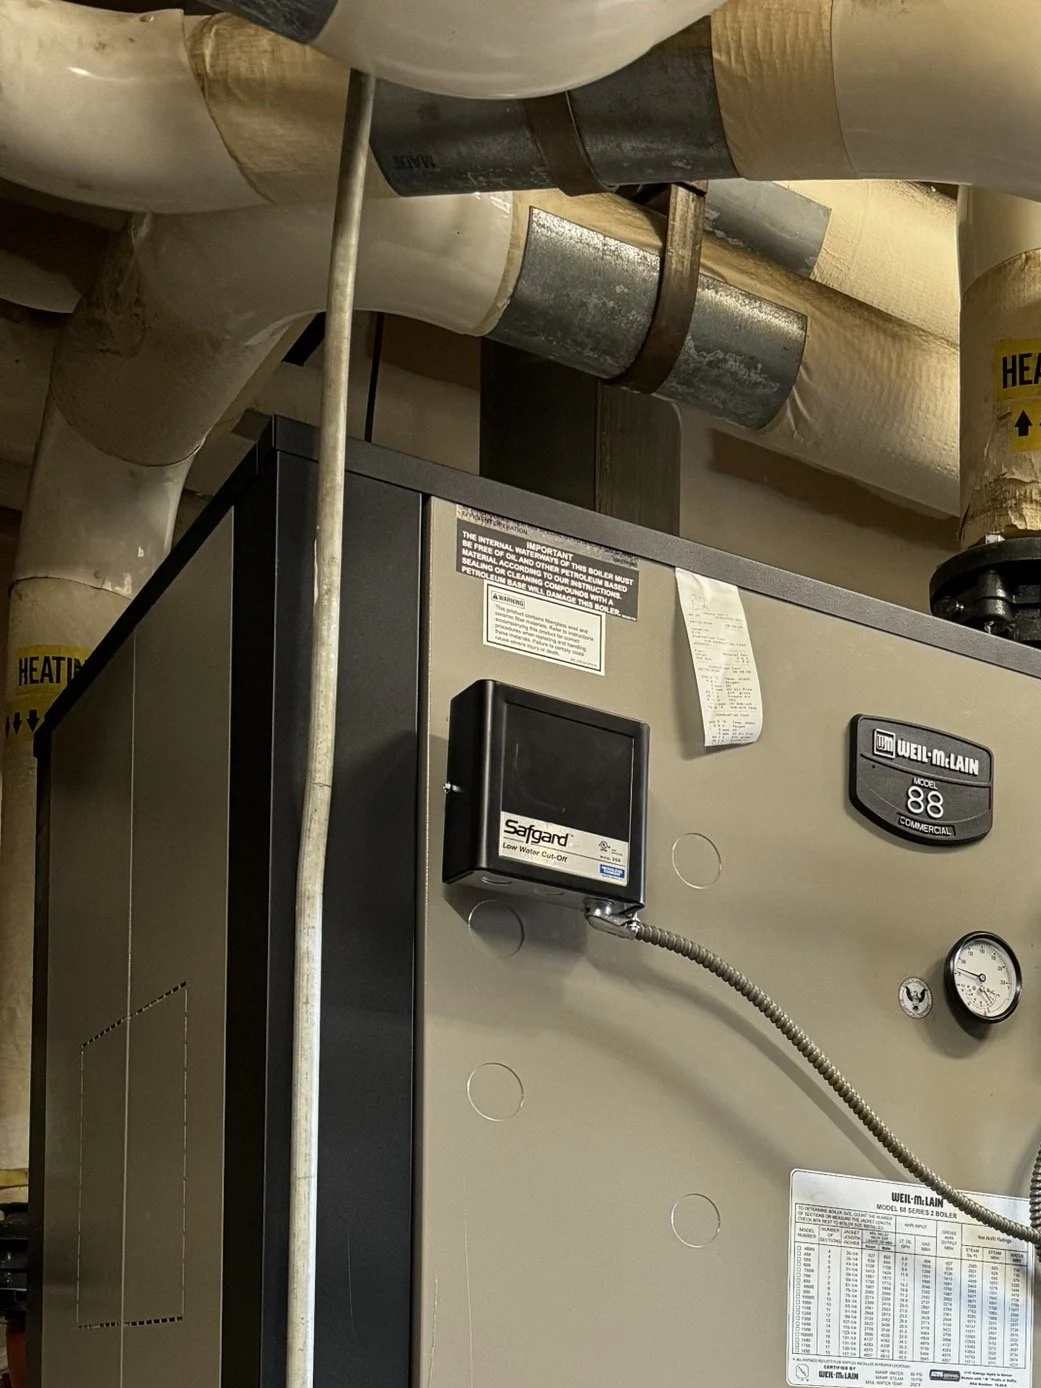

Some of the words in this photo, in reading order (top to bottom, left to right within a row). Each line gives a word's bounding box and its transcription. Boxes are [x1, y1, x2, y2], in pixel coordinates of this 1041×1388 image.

[462, 531, 476, 541] THE
[478, 535, 513, 552] INTERNAL
[515, 546, 558, 564] WATERWAYS
[560, 559, 570, 568] OF
[572, 562, 587, 573] THIS
[589, 566, 613, 580] BOILER
[615, 574, 633, 586] MUST
[527, 542, 573, 561] IMPORTANT
[462, 540, 472, 549] BE
[474, 543, 493, 555] FREE
[495, 549, 504, 558] OF
[506, 552, 517, 562] OIL
[519, 556, 534, 566] AND
[536, 560, 559, 573] OTHER
[561, 567, 602, 585] PETROLEUM
[605, 580, 628, 592] BASED
[462, 549, 497, 565] MATERIAL
[500, 560, 541, 578] ACCORDING
[543, 572, 552, 581] TO
[554, 575, 570, 585] OUR
[571, 579, 622, 600] INSTRUCTIONS.
[462, 558, 493, 573] SEALING
[495, 567, 505, 576] OR
[508, 570, 542, 586] CLEANING
[545, 580, 589, 599] COMPOUNDS
[591, 593, 606, 603] WITH
[608, 597, 613, 605] A
[462, 566, 506, 584] PETROLEUM
[508, 579, 526, 590] BASE
[528, 584, 545, 595] WILL
[547, 589, 576, 603] DAMAGE
[578, 598, 593, 608] THIS
[595, 602, 621, 616] BOILER.
[499, 596, 524, 606] WARNING
[914, 777, 938, 789] MODEL
[907, 786, 944, 818] 88
[504, 819, 569, 847] Safgard
[900, 816, 952, 835] COMMERCIAL
[503, 842, 517, 851] Low
[520, 846, 539, 856] Water
[542, 852, 568, 862] Cut-Off
[876, 1204, 897, 1212] MODEL
[908, 1207, 929, 1215] SERIES
[936, 1210, 958, 1219] BOILER
